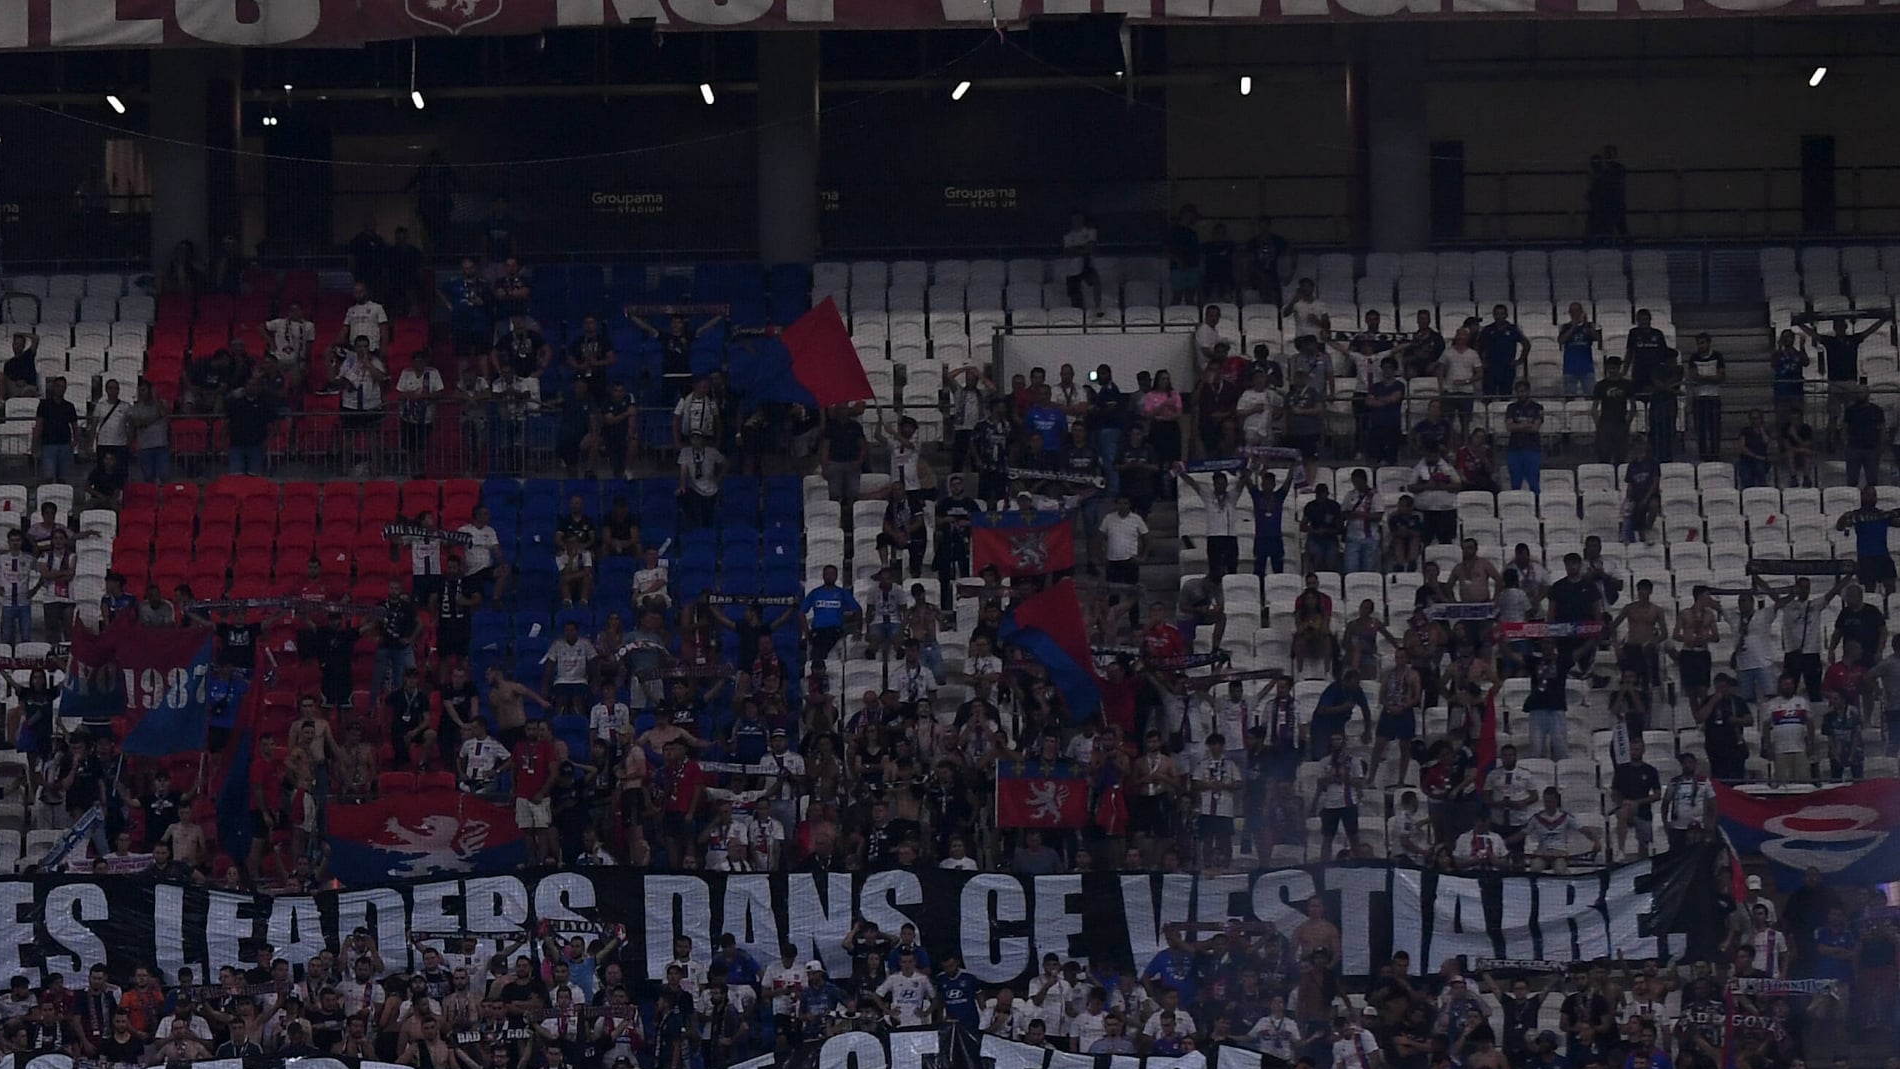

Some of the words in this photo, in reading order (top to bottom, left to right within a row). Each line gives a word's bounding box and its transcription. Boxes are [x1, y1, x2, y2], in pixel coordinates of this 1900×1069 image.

[592, 191, 663, 205] Groupama
[123, 663, 211, 710] 1987
[155, 871, 597, 987] LEADERS
[644, 869, 924, 992] DANS
[960, 871, 1089, 985] CE
[1117, 866, 1688, 976] VESTIAIRE.
[559, 920, 605, 933] LYON
[457, 1031, 481, 1044] BAD
